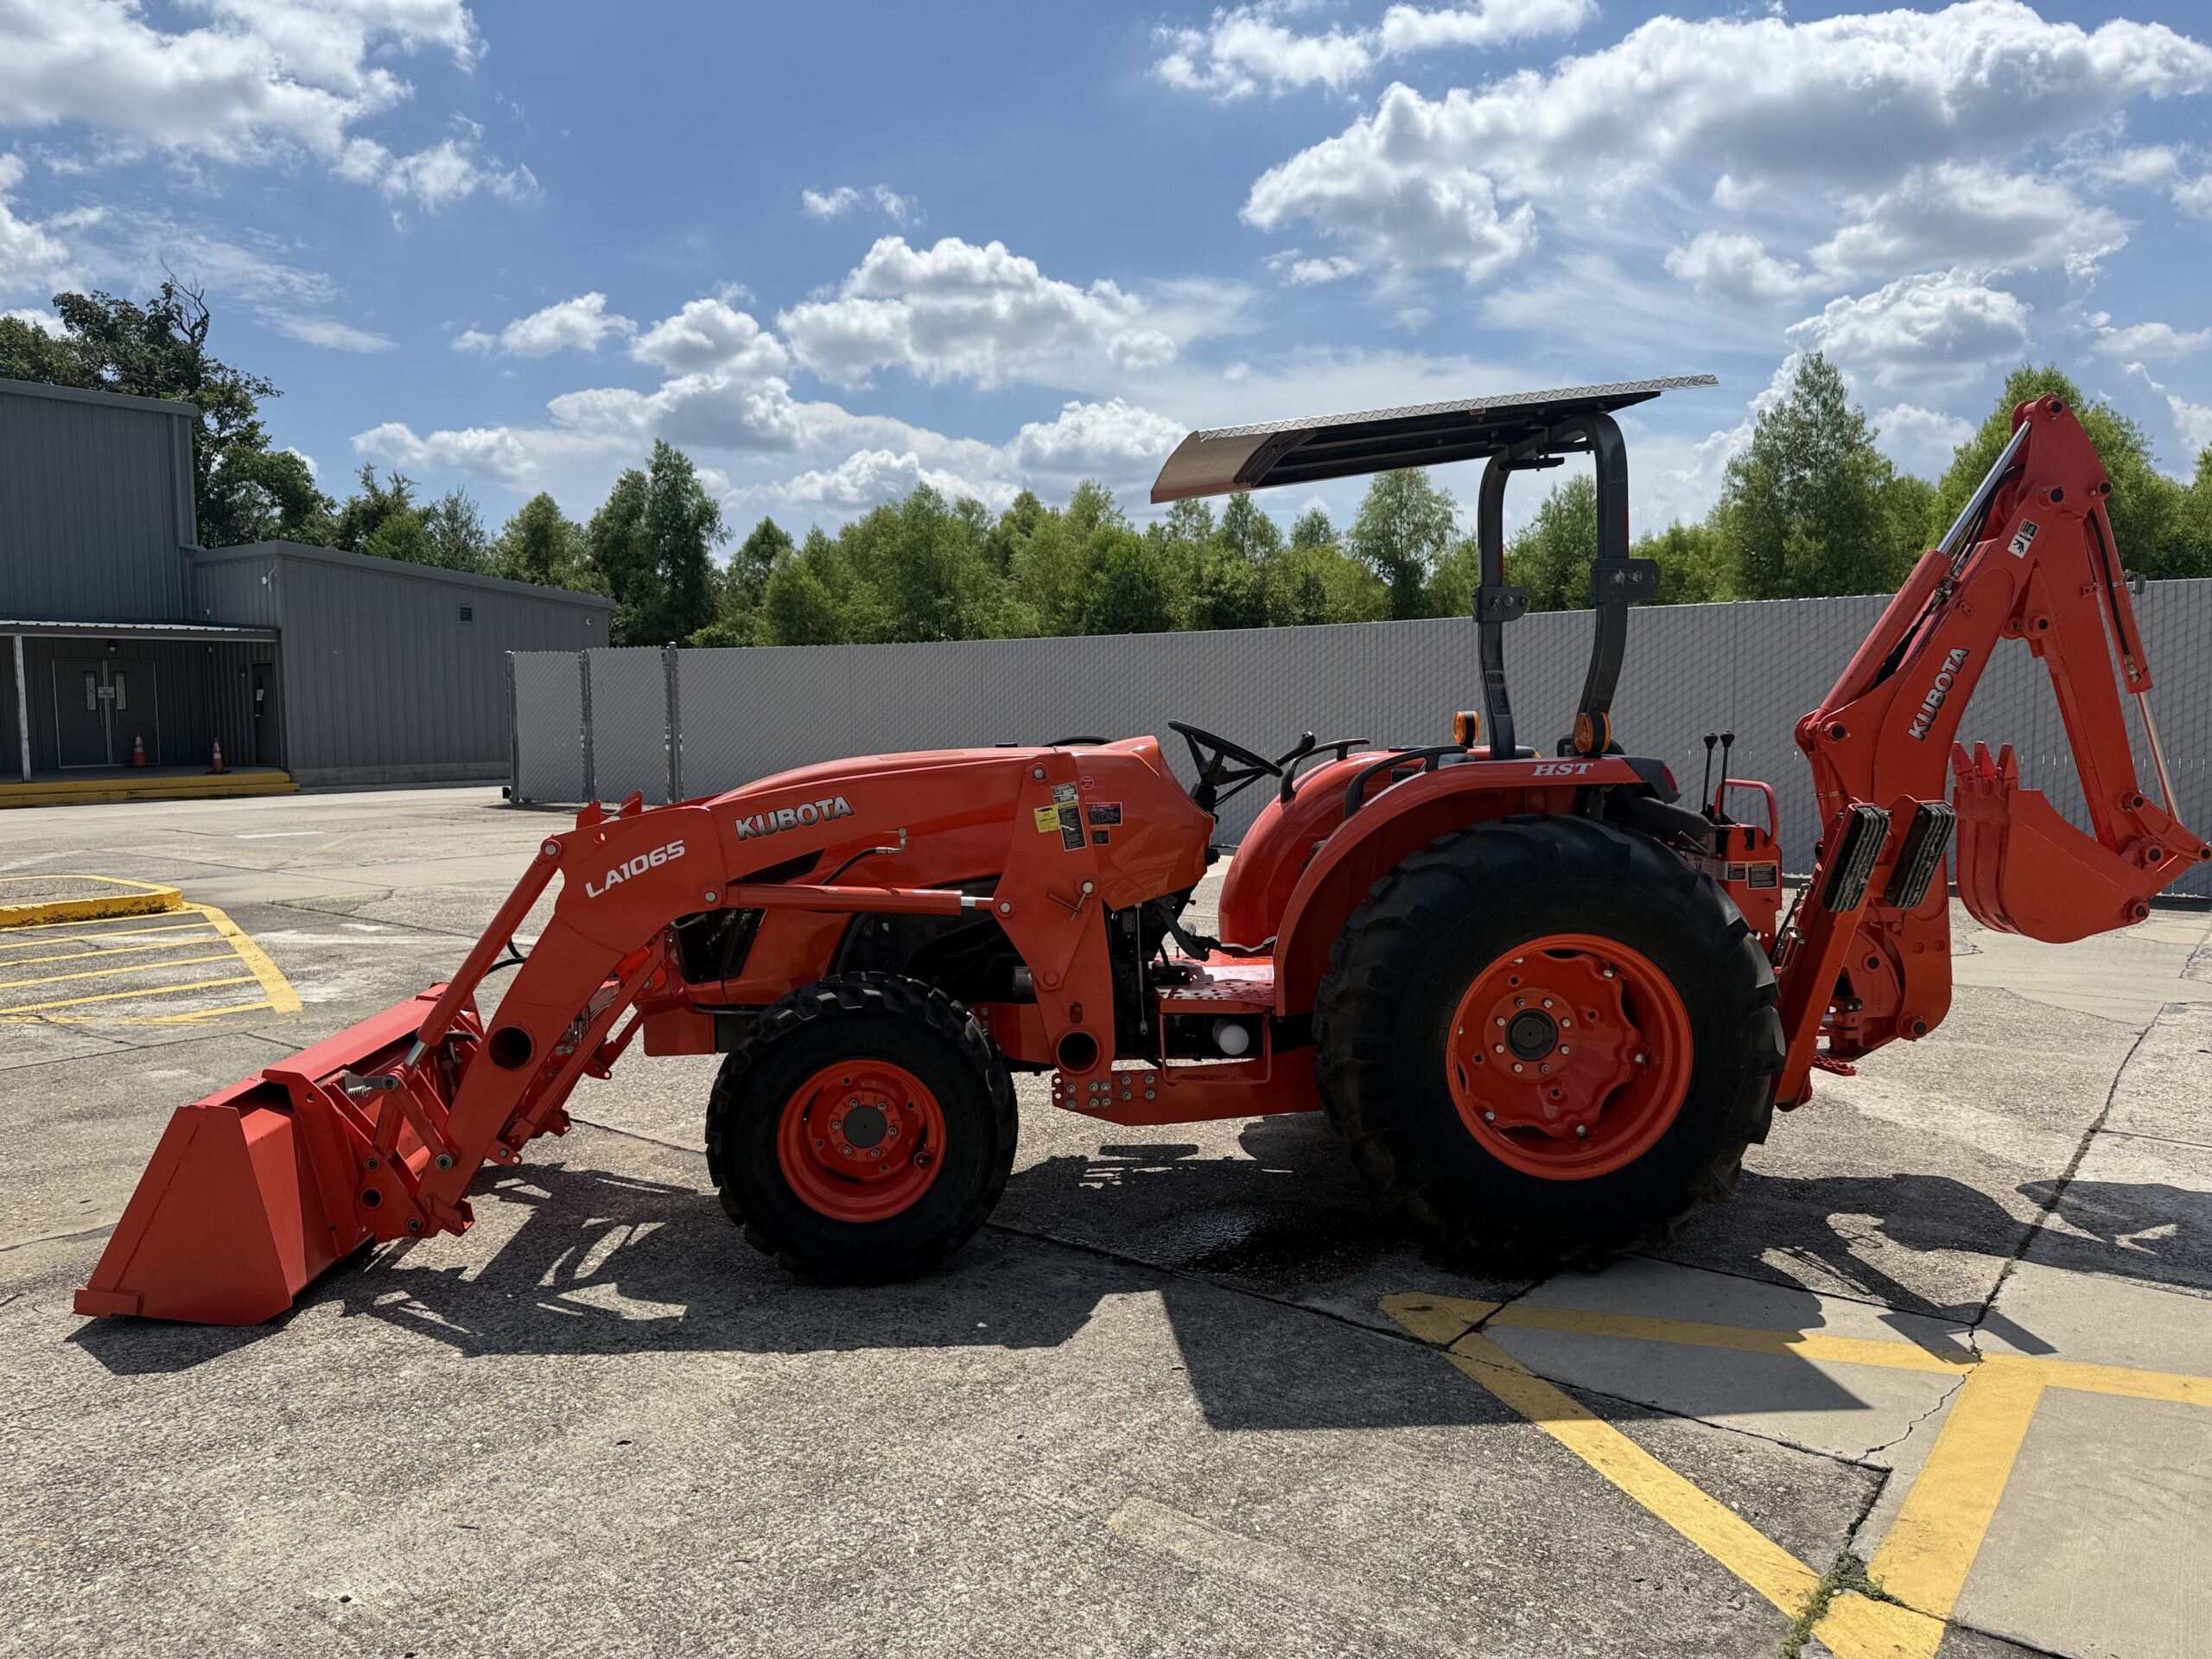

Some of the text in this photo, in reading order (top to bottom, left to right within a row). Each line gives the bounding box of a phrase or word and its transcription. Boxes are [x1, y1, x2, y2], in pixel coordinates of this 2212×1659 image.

[1907, 647, 1970, 741] KUBOTA
[1532, 762, 1594, 776] HST
[734, 795, 855, 842] KUBOTA
[585, 839, 685, 899] LA1065
